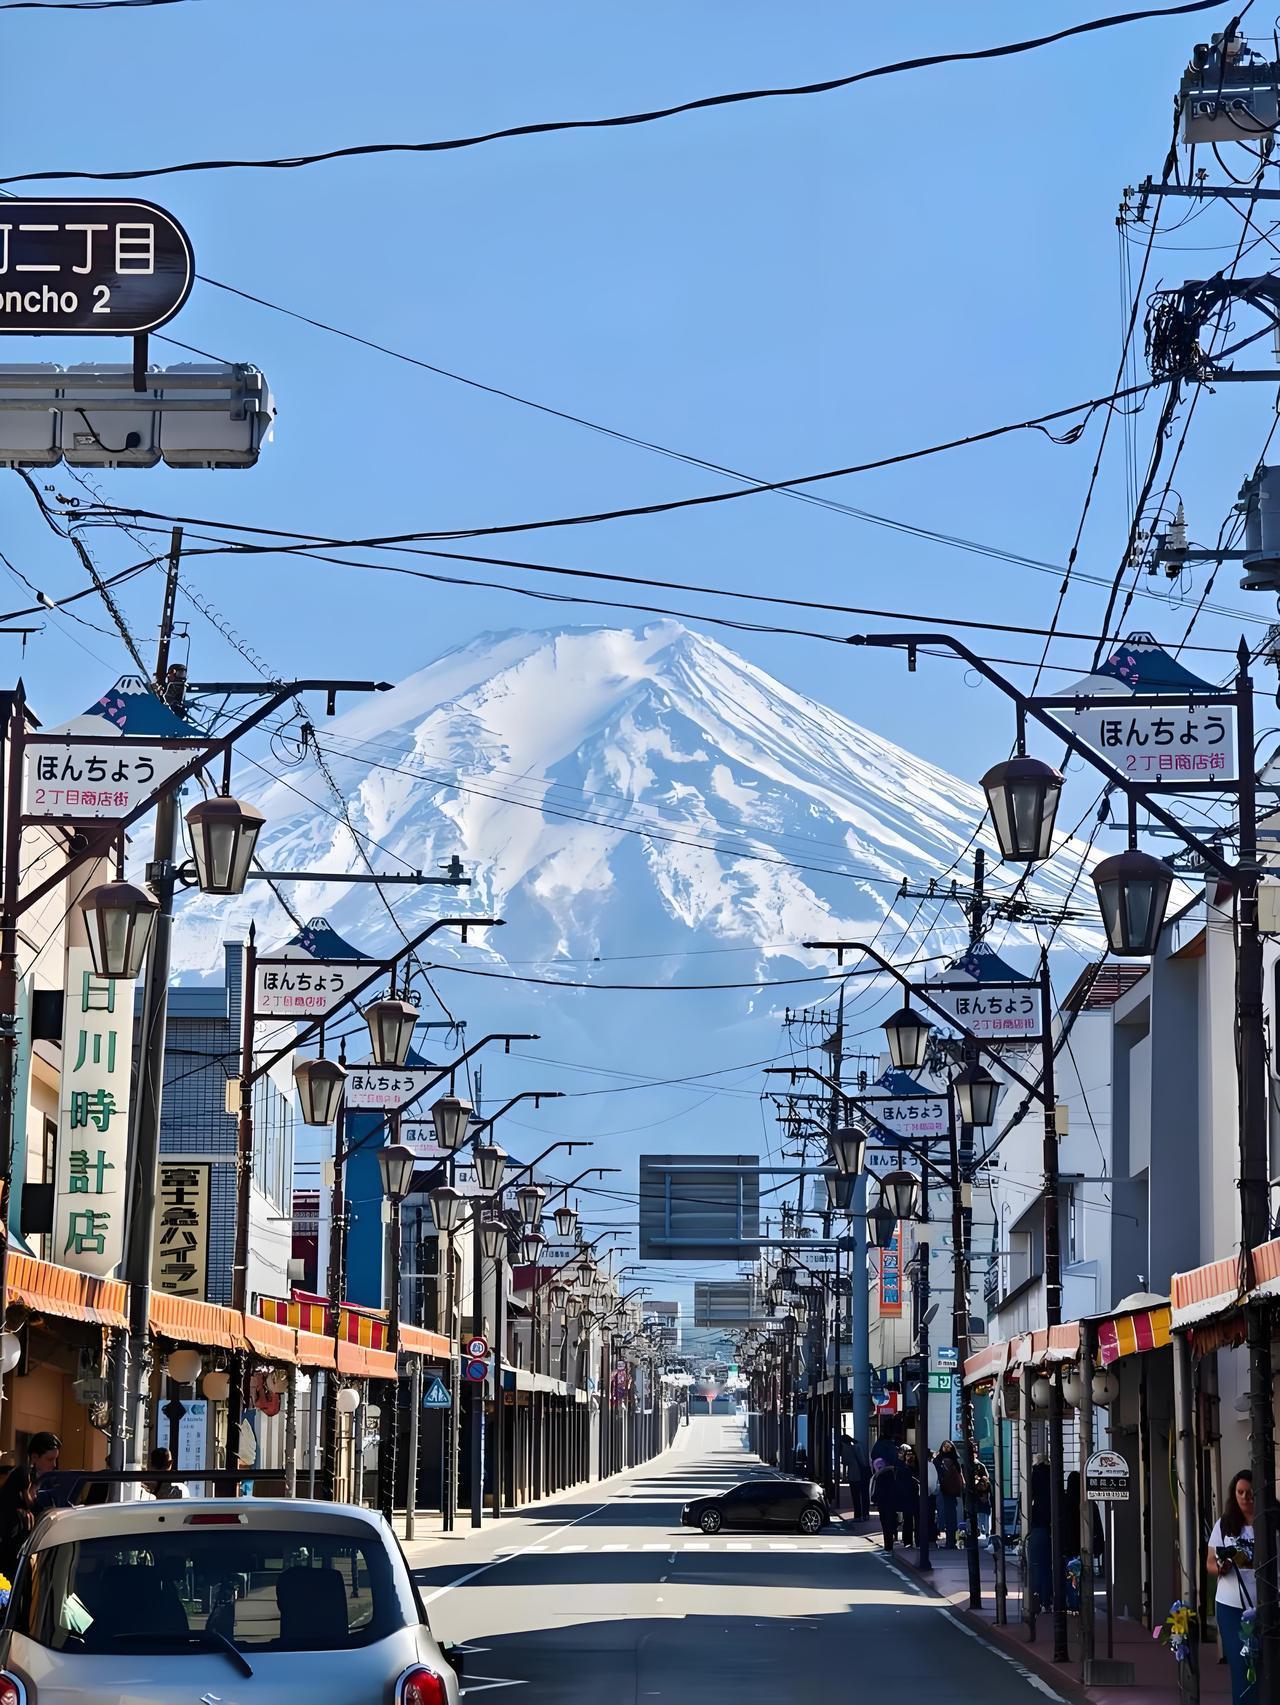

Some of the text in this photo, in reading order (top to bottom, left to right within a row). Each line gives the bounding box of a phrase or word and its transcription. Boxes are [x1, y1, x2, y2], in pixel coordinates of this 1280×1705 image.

[0, 285, 111, 313] ncho 2
[1100, 716, 1225, 746] ほんちょう
[37, 754, 154, 782] ほんちょう
[1126, 753, 1225, 770] 2丁目商店街
[35, 788, 129, 806] 2丁目商店街
[264, 972, 344, 992] ほんちょう
[956, 995, 1034, 1014] ほんちょう
[352, 1076, 414, 1091] ほんちょう
[883, 1104, 943, 1120] ほんちょう
